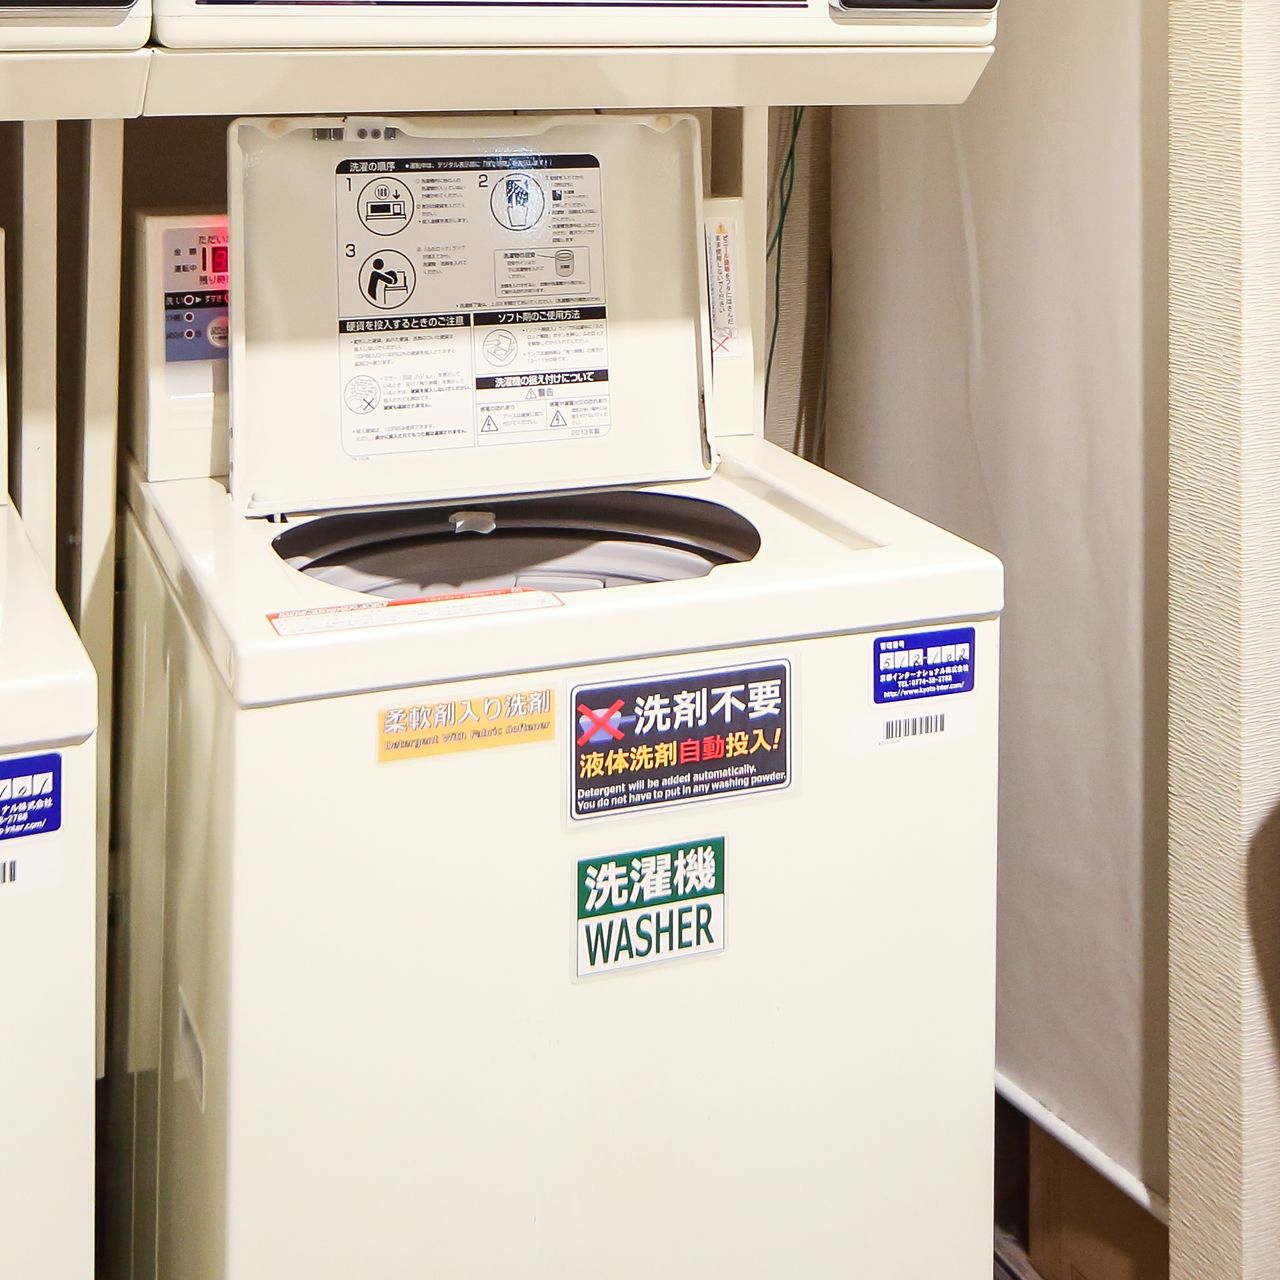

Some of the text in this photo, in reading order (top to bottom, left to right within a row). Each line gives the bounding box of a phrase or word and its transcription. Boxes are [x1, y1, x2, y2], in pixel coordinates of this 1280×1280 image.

[346, 177, 353, 192] 1
[478, 173, 489, 188] 2
[345, 243, 356, 258] 3
[346, 315, 465, 332] 硬貨を投入するときのご注意
[497, 309, 581, 323] ソフト剤のご使用方法
[384, 689, 551, 734] 柔軟剤入り洗剤
[634, 679, 783, 736] 洗剤不要
[577, 784, 626, 800] Detergent
[628, 781, 644, 791] will
[647, 778, 660, 789] be
[661, 772, 691, 786] added
[577, 799, 596, 811] You
[596, 796, 610, 808] do
[611, 795, 628, 805] not
[628, 791, 652, 803] have
[653, 789, 663, 800] to
[664, 787, 681, 800] put
[682, 784, 692, 795] in
[693, 782, 710, 796] any
[711, 776, 750, 792] washing
[584, 846, 717, 912] 洗濯機
[584, 903, 714, 967] WASHER
